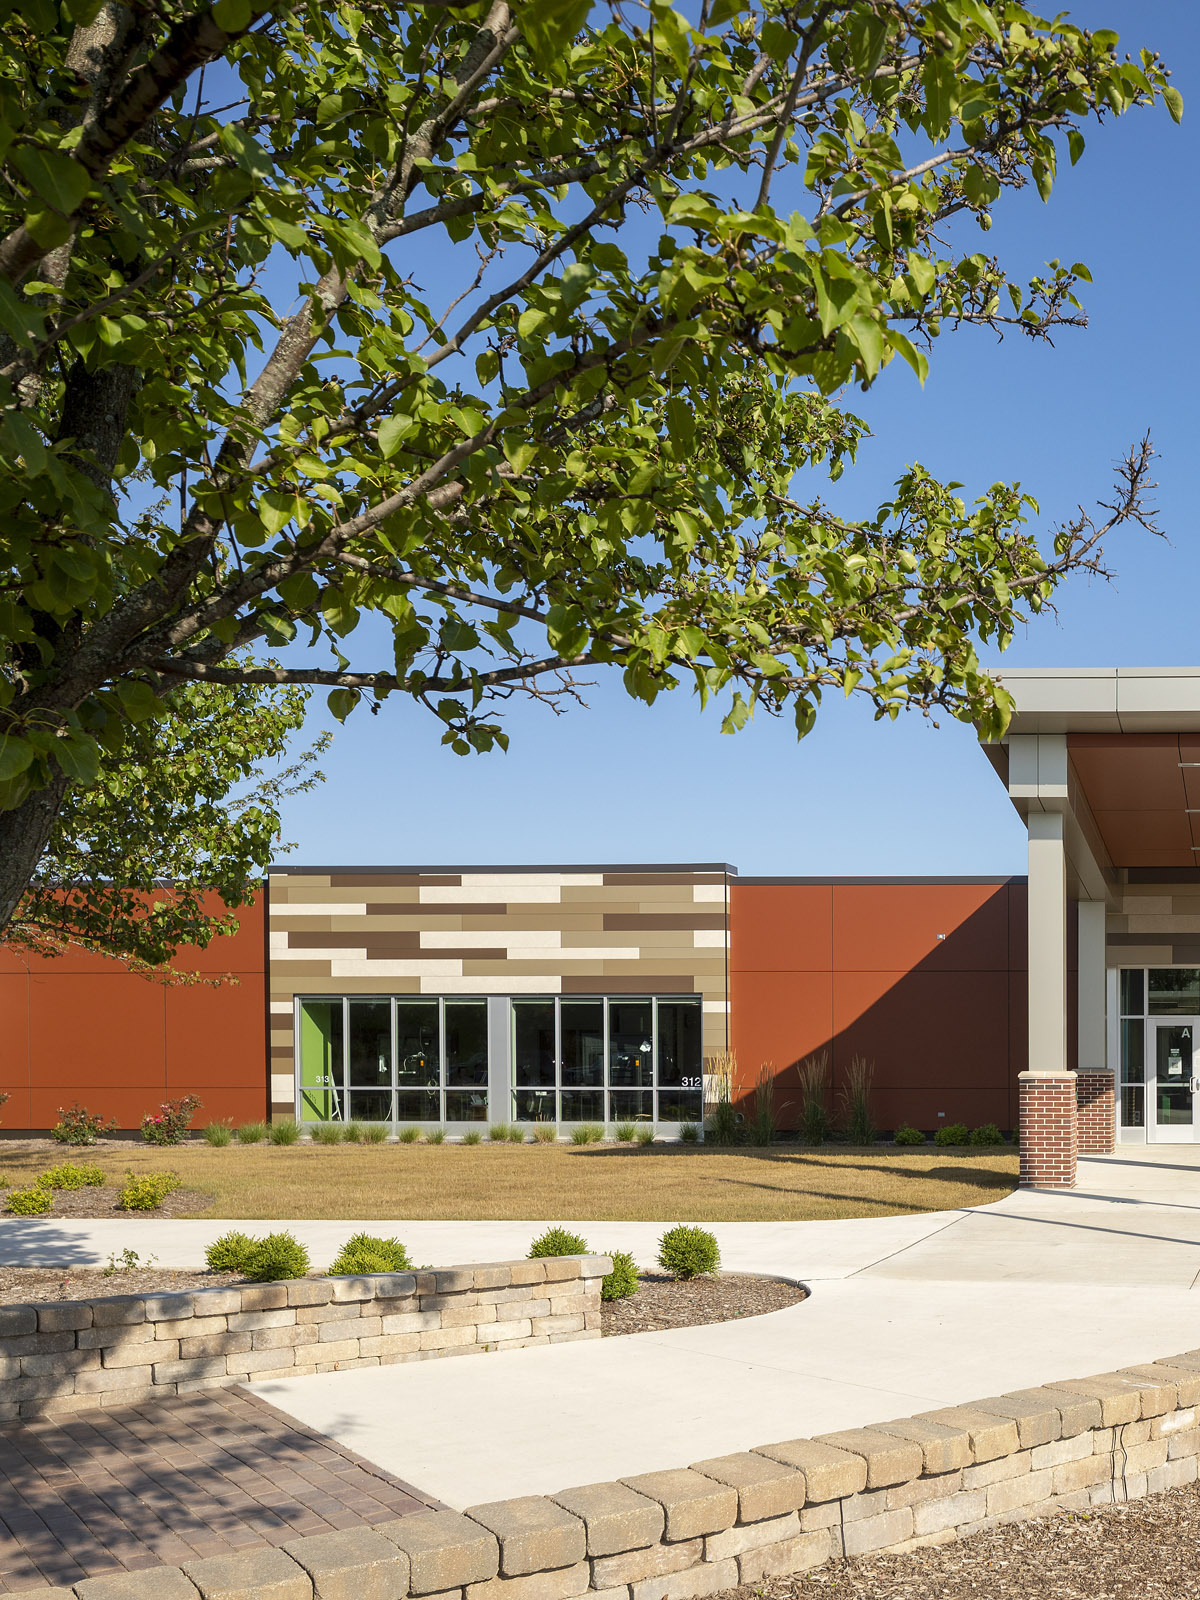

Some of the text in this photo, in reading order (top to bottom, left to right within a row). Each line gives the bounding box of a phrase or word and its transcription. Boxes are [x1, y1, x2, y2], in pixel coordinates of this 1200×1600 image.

[1181, 1027, 1191, 1038] A
[315, 1075, 330, 1083] 313
[681, 1076, 702, 1087] 312
